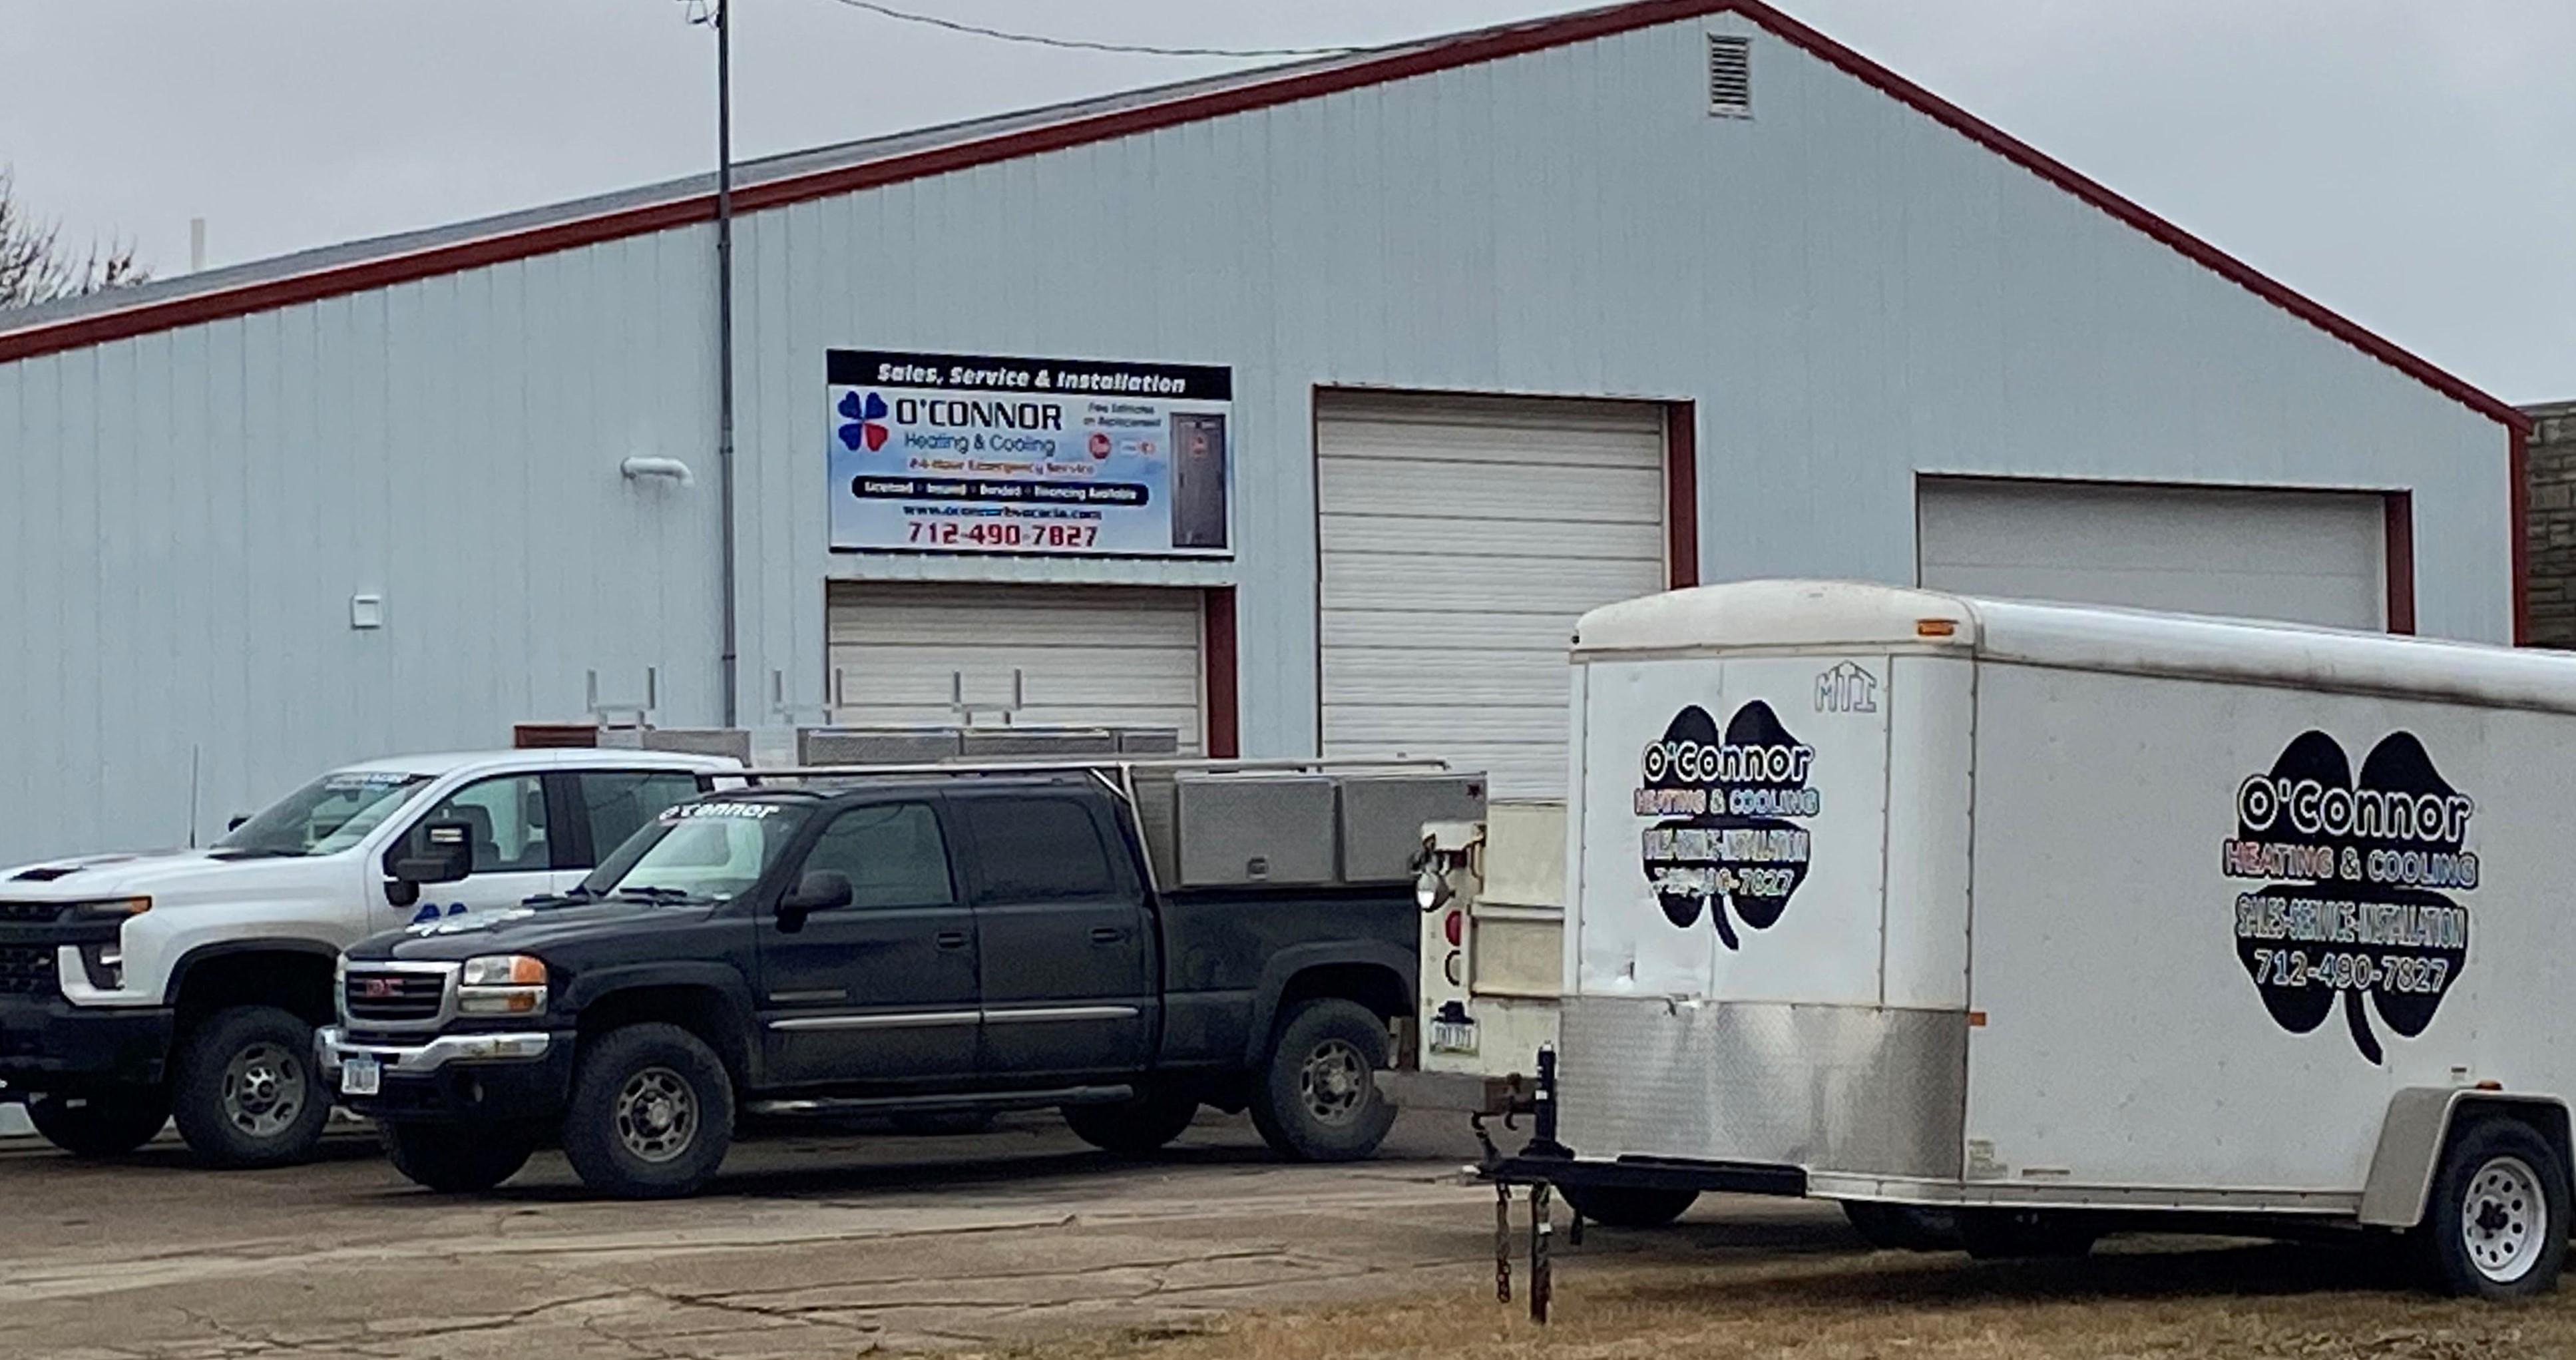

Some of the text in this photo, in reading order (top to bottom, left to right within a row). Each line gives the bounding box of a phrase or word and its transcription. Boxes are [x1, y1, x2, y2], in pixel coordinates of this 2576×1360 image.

[877, 363, 1185, 393] Sales, Service & Installation
[896, 399, 1061, 431] O'CONNOR
[905, 433, 1056, 457] Heating & Cooling
[980, 483, 1022, 497] Bonded
[908, 521, 1098, 547] 712-490-7827
[1815, 660, 1877, 713] MTI
[1644, 741, 1815, 782] O'Connor
[1635, 788, 1819, 816] HEATING & COOLING
[2240, 776, 2471, 842] O'Connor
[2225, 840, 2477, 887] HEATING & COOLING
[2255, 950, 2448, 993] 712-490-7827
